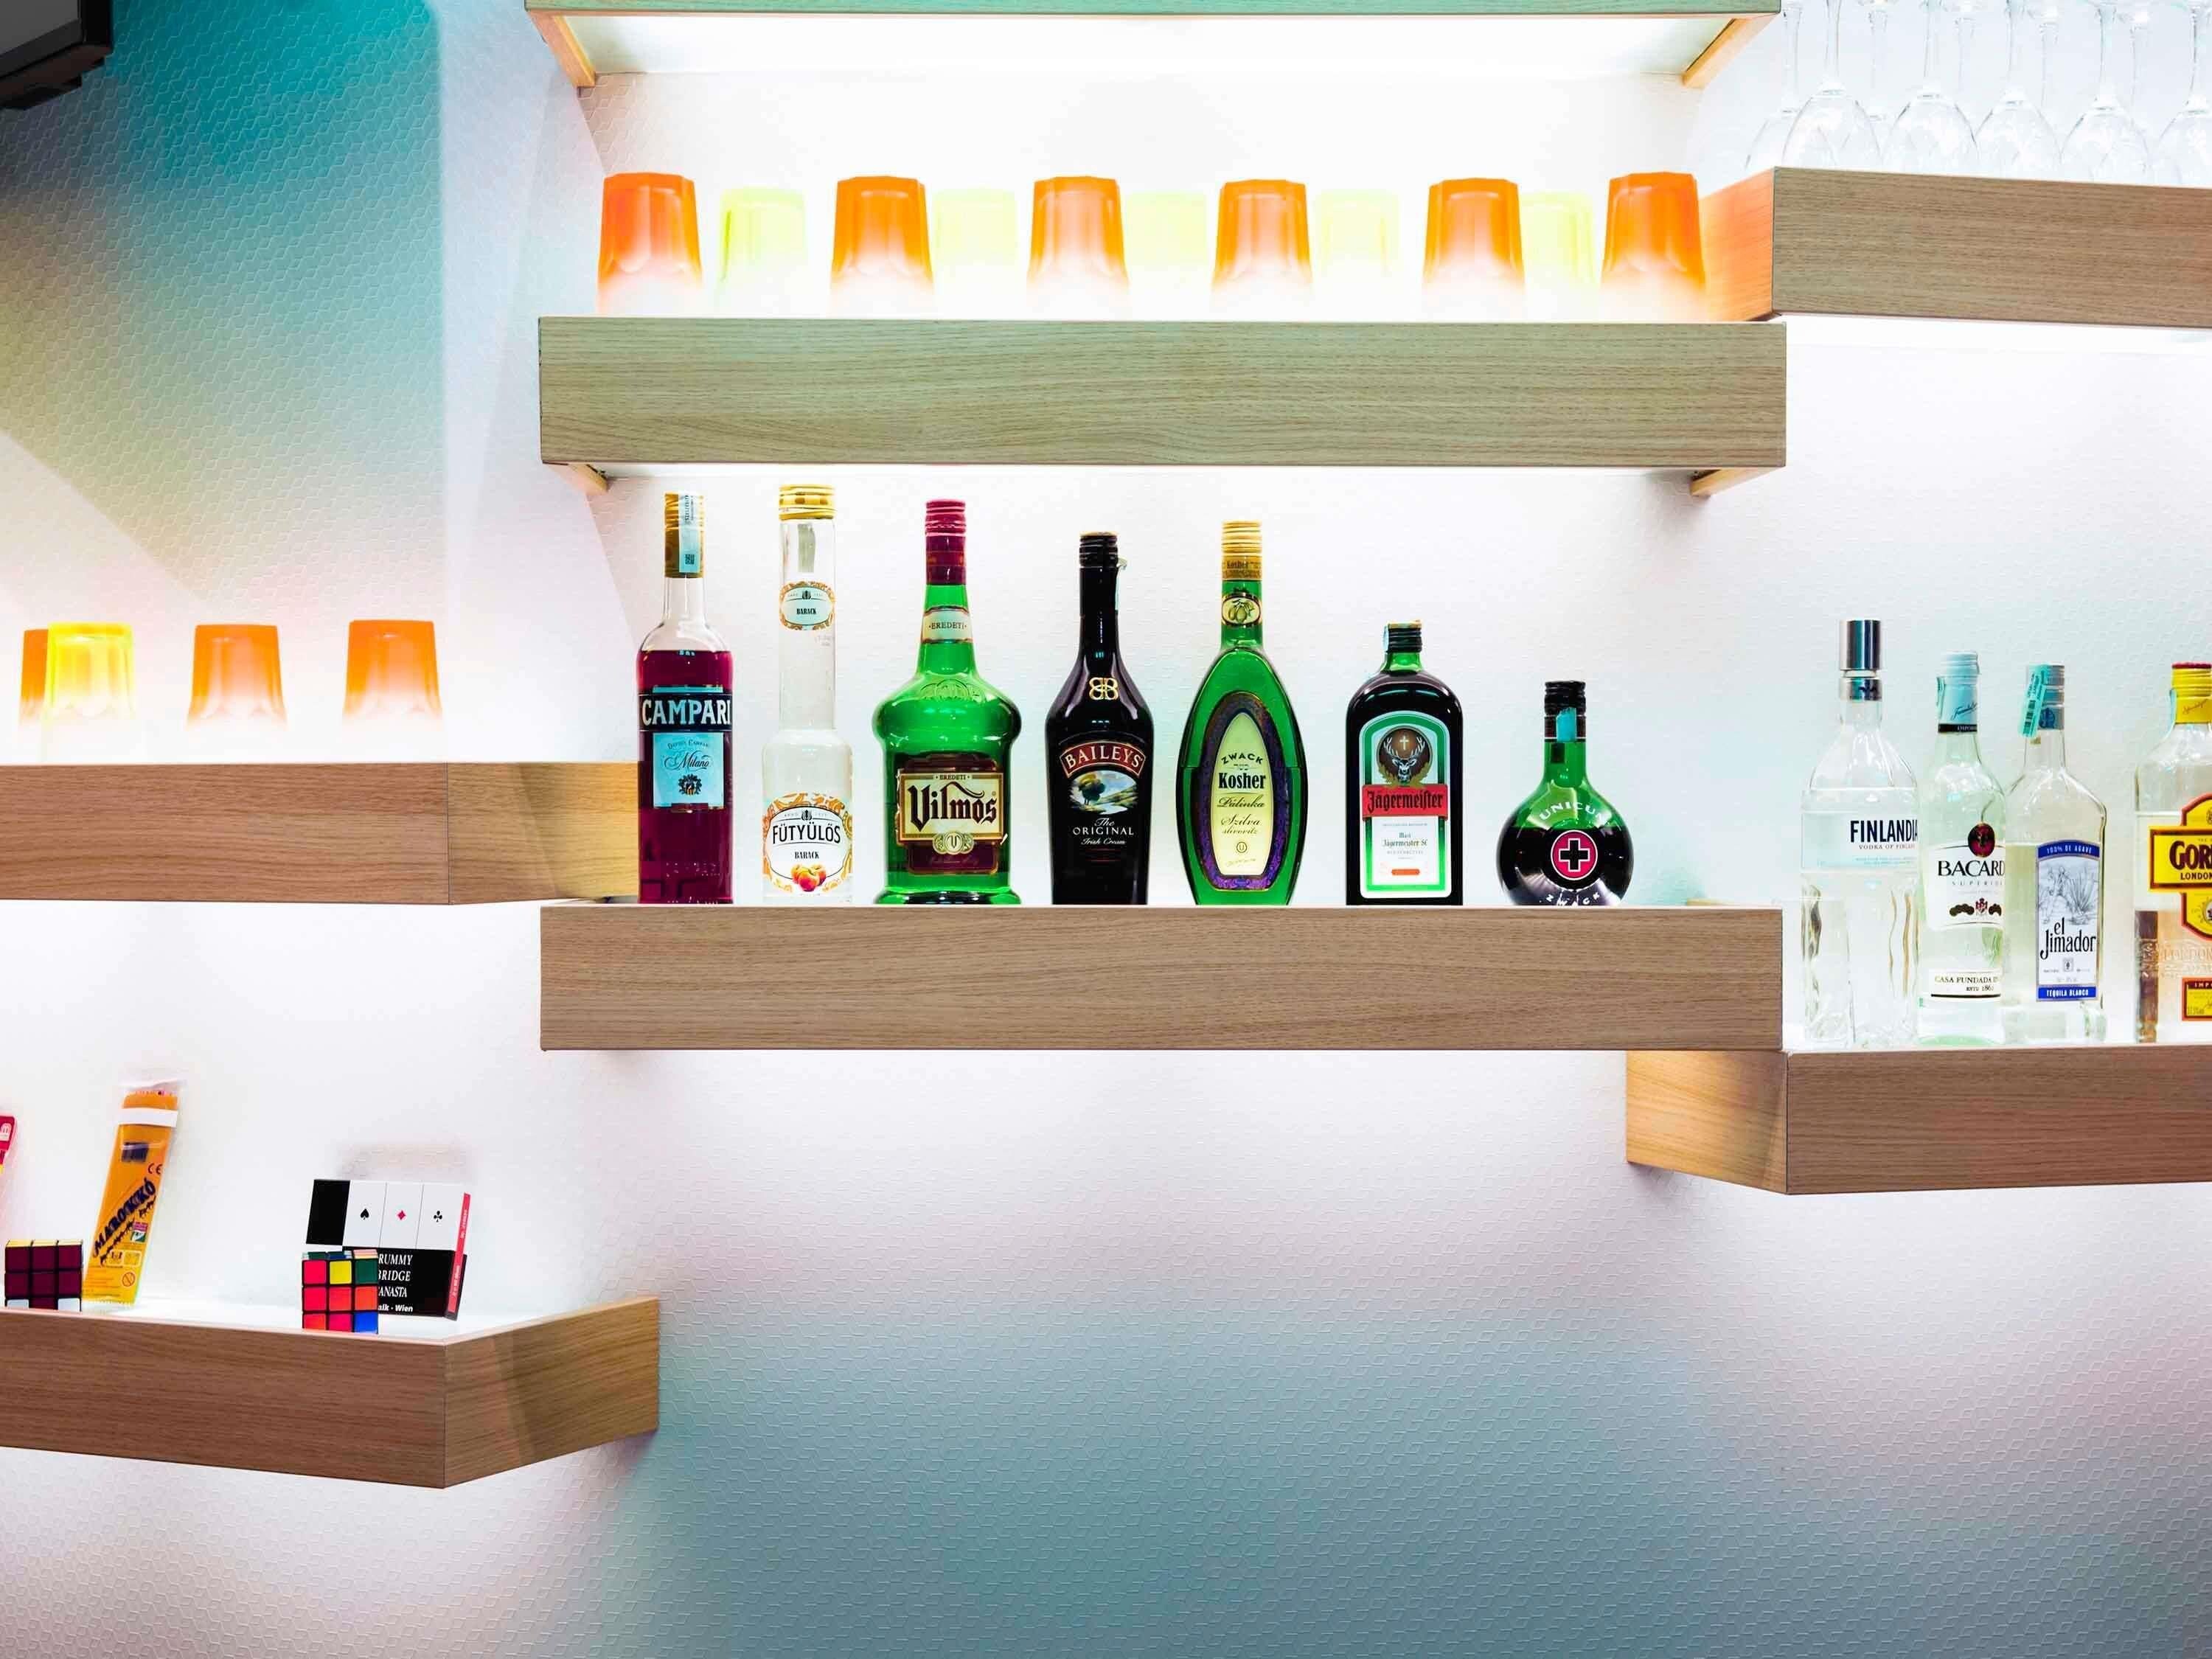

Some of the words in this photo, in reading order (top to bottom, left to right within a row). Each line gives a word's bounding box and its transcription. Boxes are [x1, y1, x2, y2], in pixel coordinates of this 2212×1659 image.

[641, 699, 731, 726] CAMPARI
[664, 750, 710, 772] Milano
[1065, 745, 1142, 769] BAILEYS
[1221, 752, 1263, 765] ZWACK
[1219, 772, 1266, 789] Kosher
[908, 782, 998, 832] Vilmos
[1217, 793, 1265, 808] Pálinka
[1094, 817, 1115, 827] The
[1221, 813, 1261, 826] Szilva
[1073, 827, 1134, 835] ORIGINAL
[1081, 838, 1102, 846] Irish
[1103, 837, 1127, 846] Cream
[794, 851, 819, 859] BARACK
[2054, 917, 2065, 935] el
[2040, 929, 2097, 960] Jimador
[378, 1253, 413, 1266] RUMMY
[378, 1285, 408, 1298] ANASTA
[395, 1304, 414, 1312] Wien
